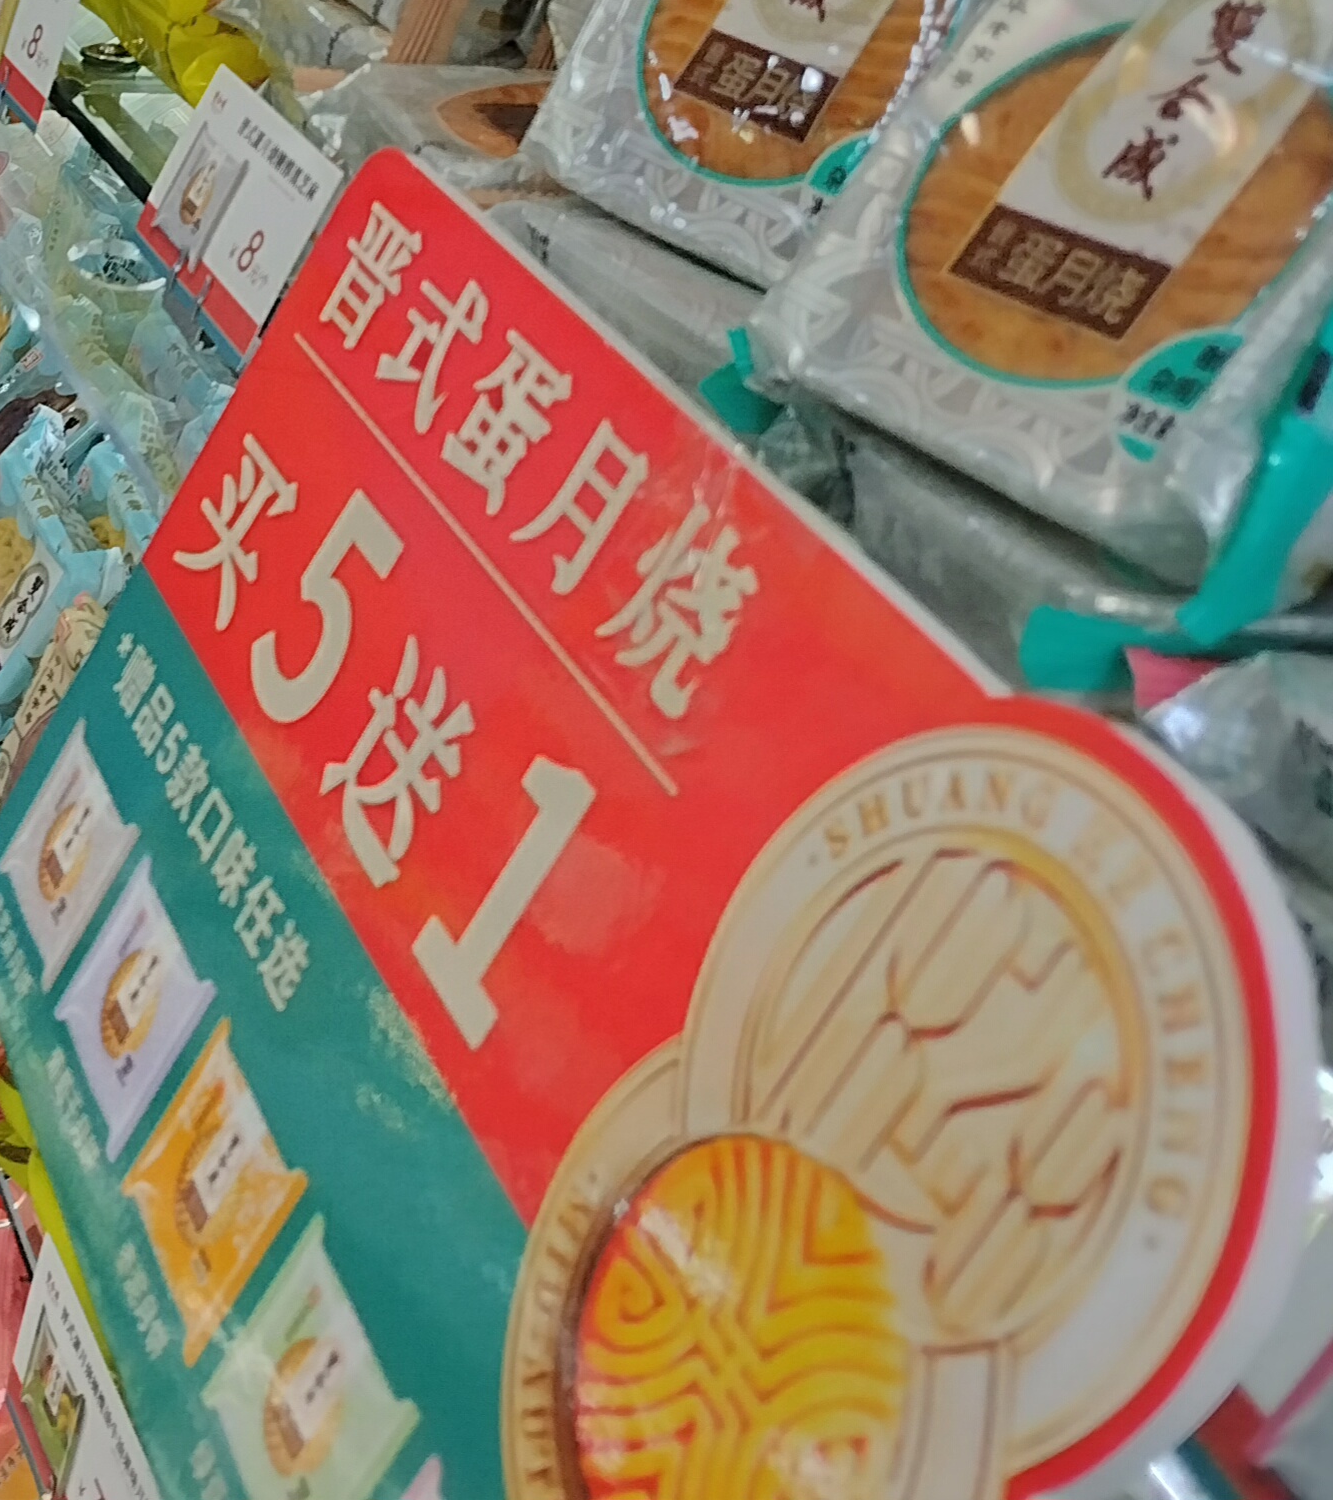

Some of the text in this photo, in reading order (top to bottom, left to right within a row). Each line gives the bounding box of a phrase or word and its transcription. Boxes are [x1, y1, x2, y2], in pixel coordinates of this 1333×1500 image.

[997, 230, 1149, 326] 蛋月烧
[320, 199, 759, 719] 晋式蛋月烧
[171, 433, 597, 1052] 买5送1
[820, 772, 1055, 860] SHUANG
